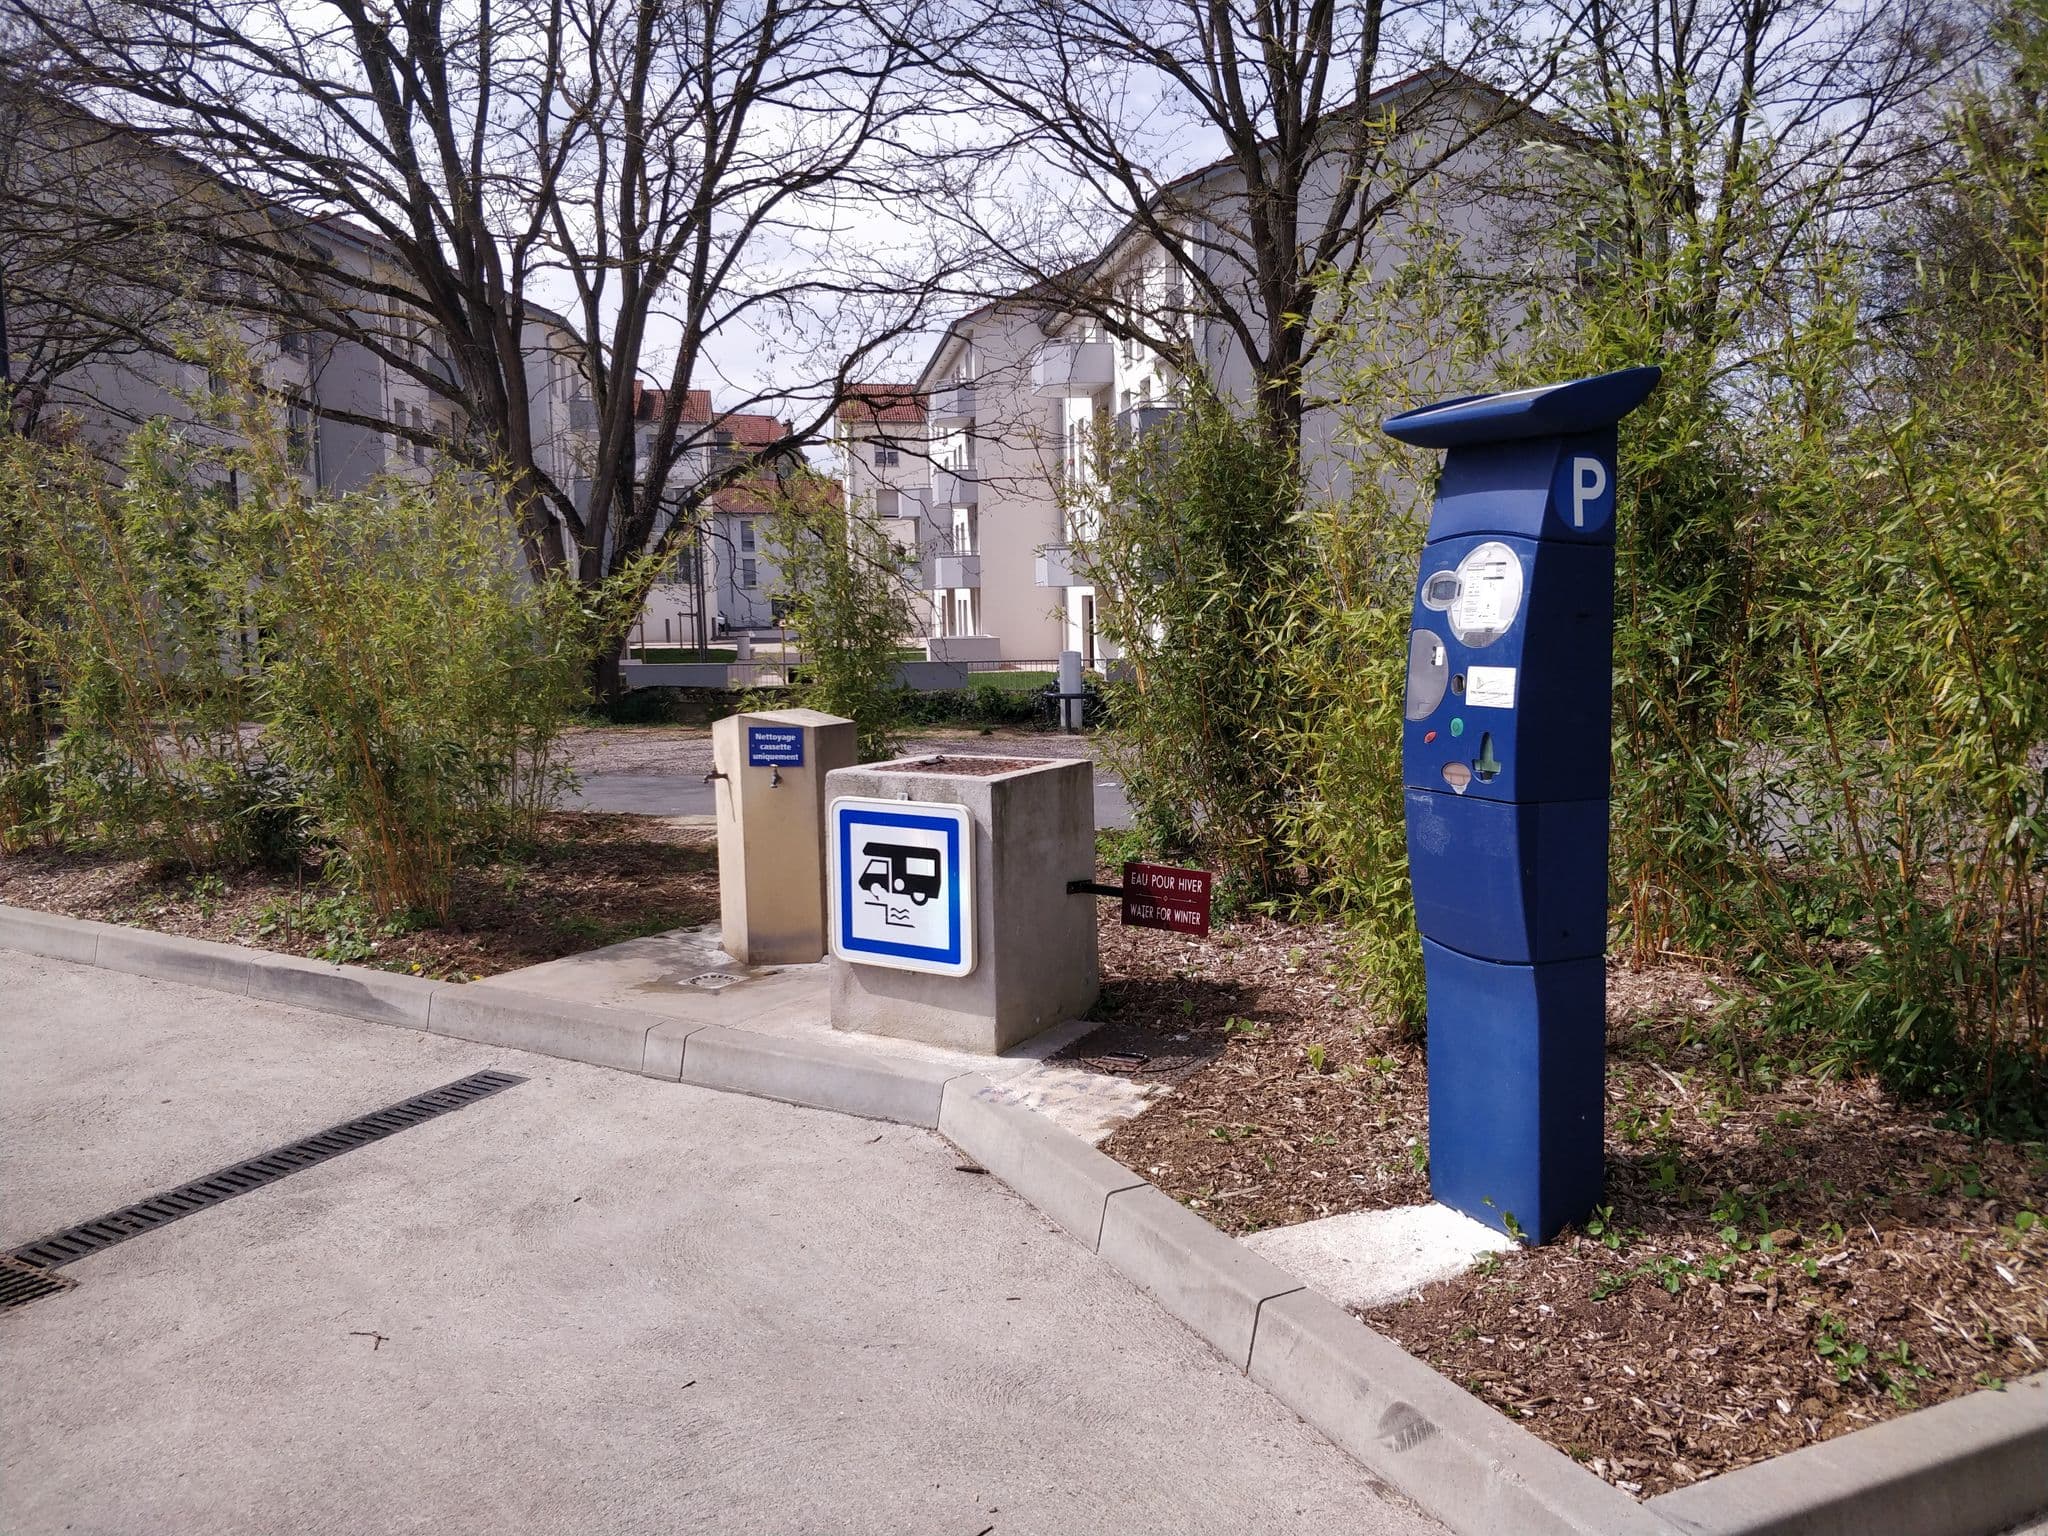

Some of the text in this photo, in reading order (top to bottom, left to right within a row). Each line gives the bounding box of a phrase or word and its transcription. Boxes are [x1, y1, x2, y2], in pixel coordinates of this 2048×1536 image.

[1573, 457, 1606, 527] P
[755, 733, 796, 742] Nettoyage
[752, 752, 799, 761] uniquement
[1131, 872, 1203, 893] EAU POUR HIVER
[1130, 903, 1201, 925] WATER FOR WINTER
